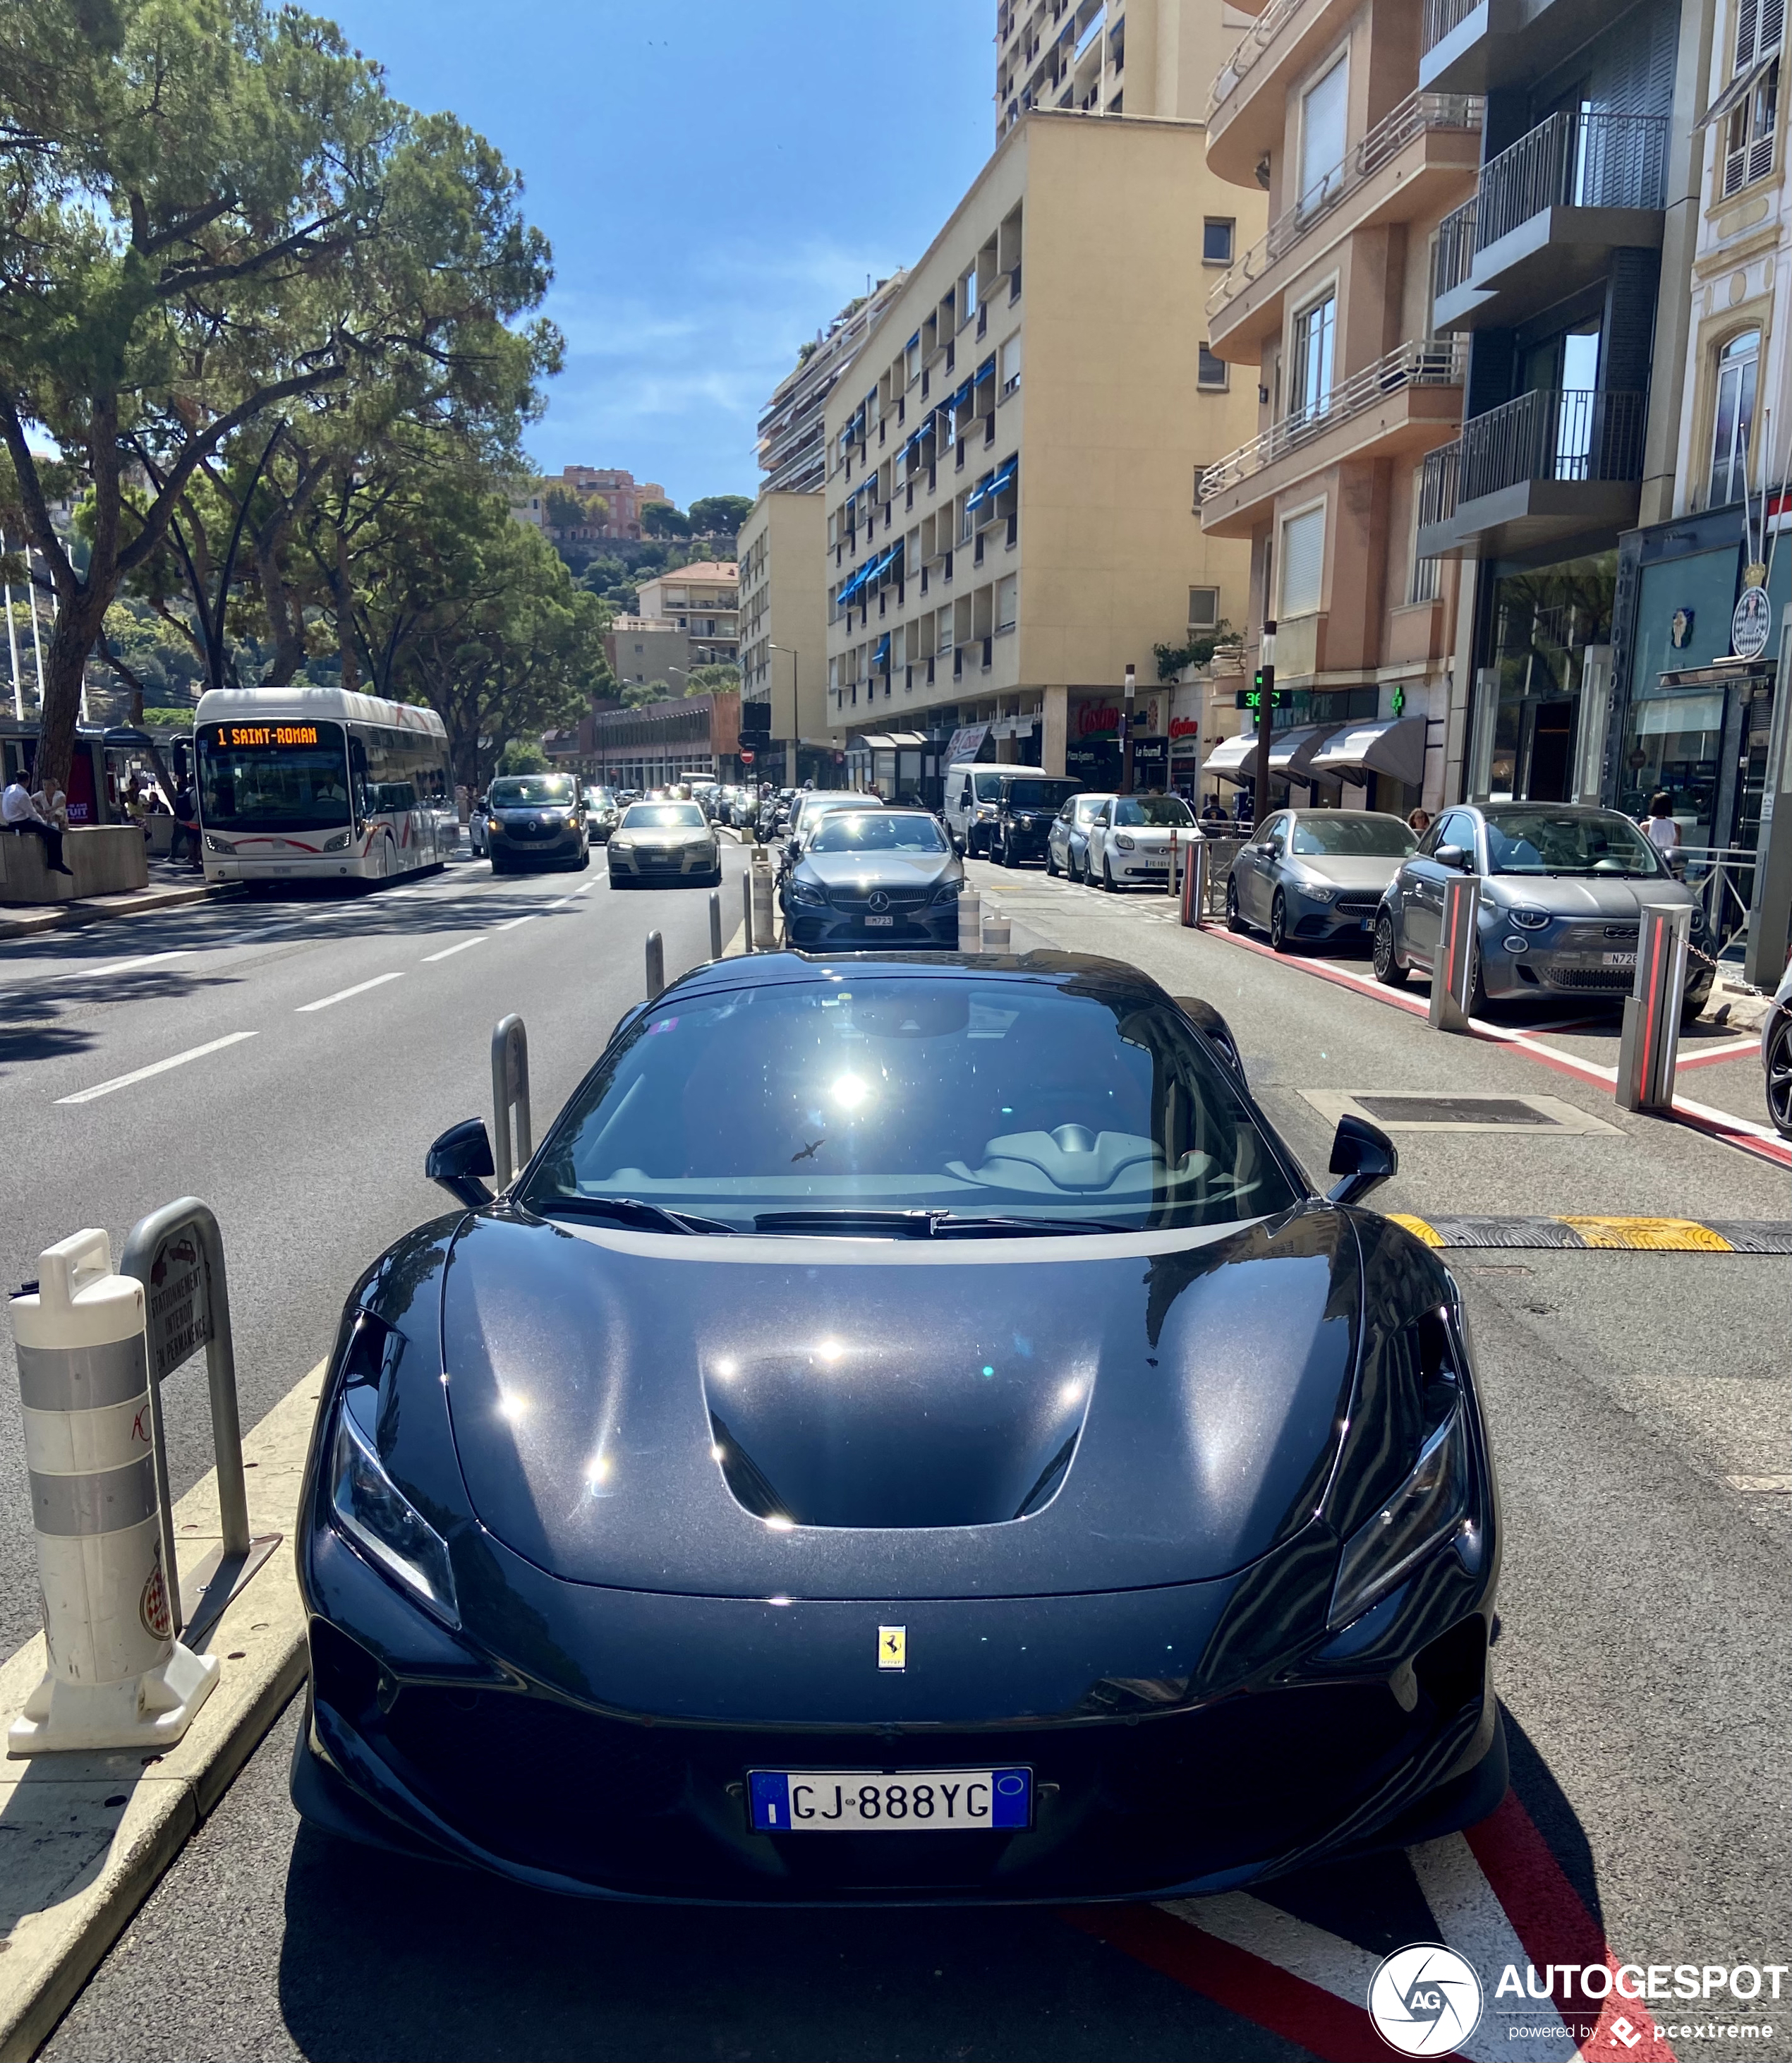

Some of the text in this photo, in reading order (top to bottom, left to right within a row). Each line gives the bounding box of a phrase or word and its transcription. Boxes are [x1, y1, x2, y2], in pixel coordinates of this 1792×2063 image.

[218, 727, 317, 745] 1 SAINT-ROMAN
[1169, 716, 1198, 739] Casino
[1135, 746, 1142, 757] Le
[151, 1266, 201, 1319] STATIONNEMENT
[164, 1299, 193, 1337] INTERDIT
[166, 1315, 207, 1365] PERMANENCE
